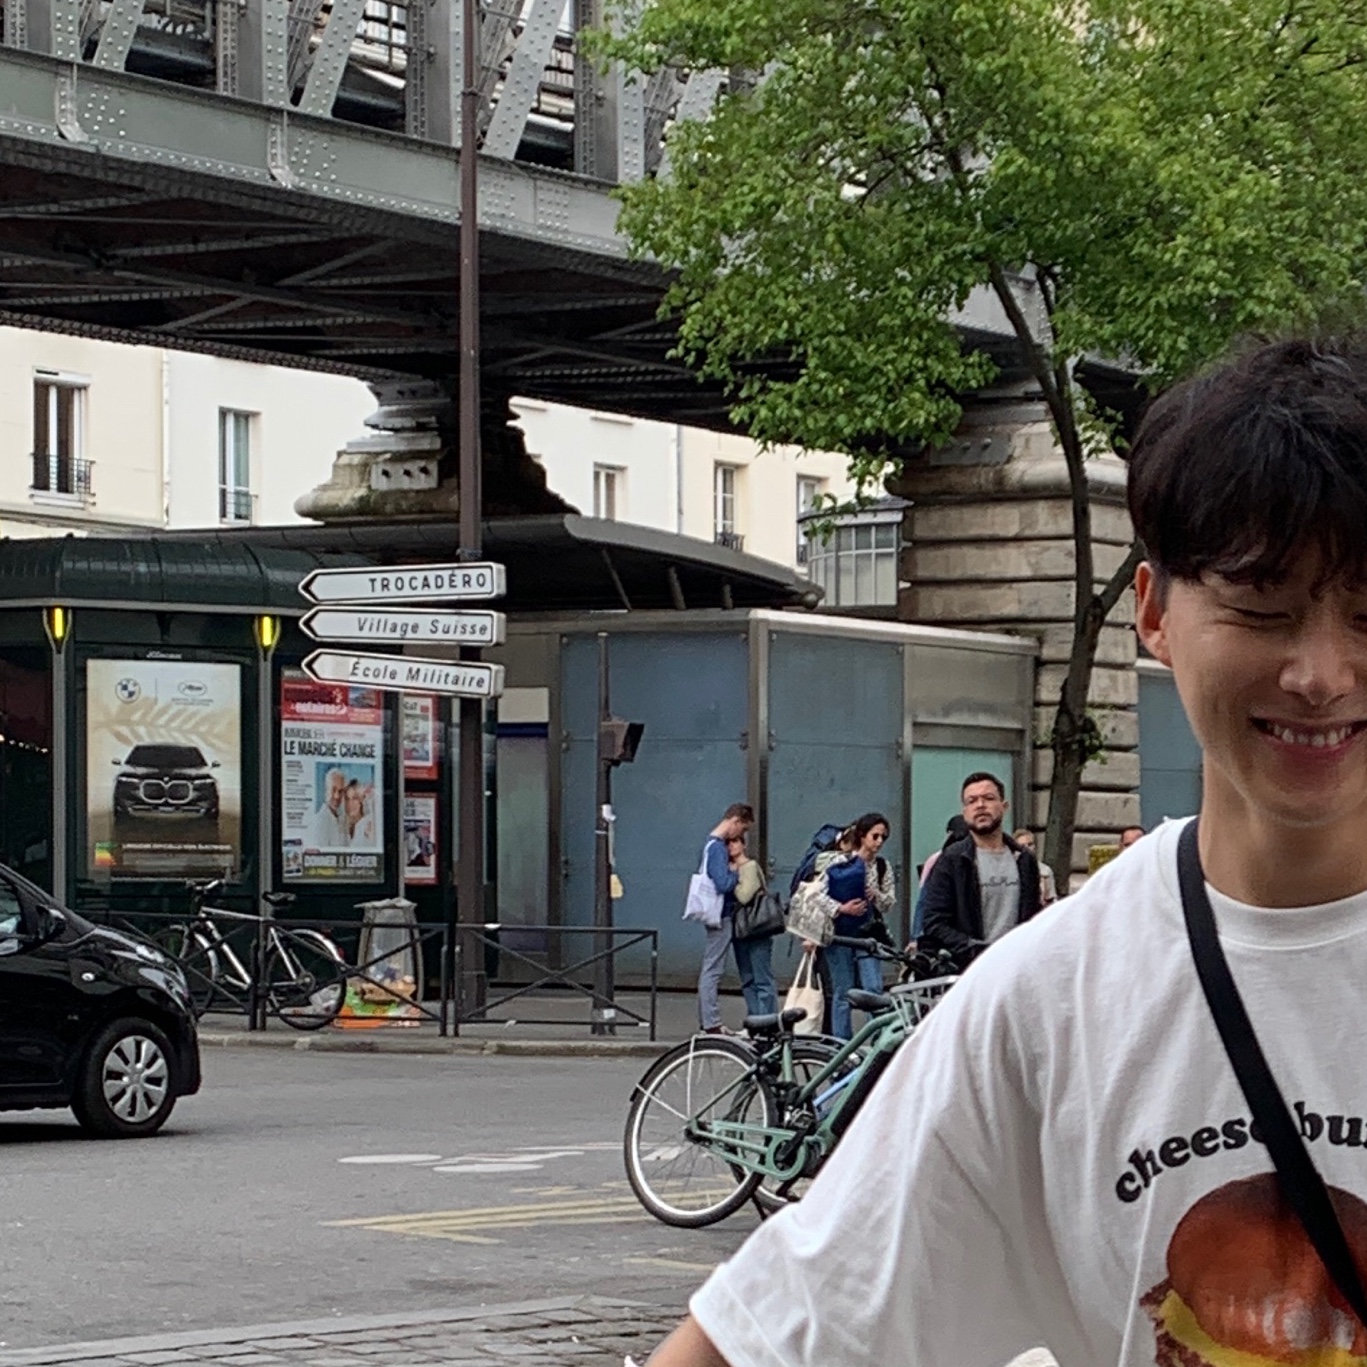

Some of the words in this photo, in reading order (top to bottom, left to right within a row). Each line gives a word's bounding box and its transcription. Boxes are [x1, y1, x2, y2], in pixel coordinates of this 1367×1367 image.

[368, 570, 487, 593] TROCADÉRO
[357, 616, 420, 639] Village
[429, 619, 488, 637] Suisse
[350, 657, 398, 680] École
[405, 666, 486, 689] Militaire
[283, 740, 296, 756] LE
[298, 738, 337, 757] MARCHÉ
[339, 742, 376, 759] CHANGE
